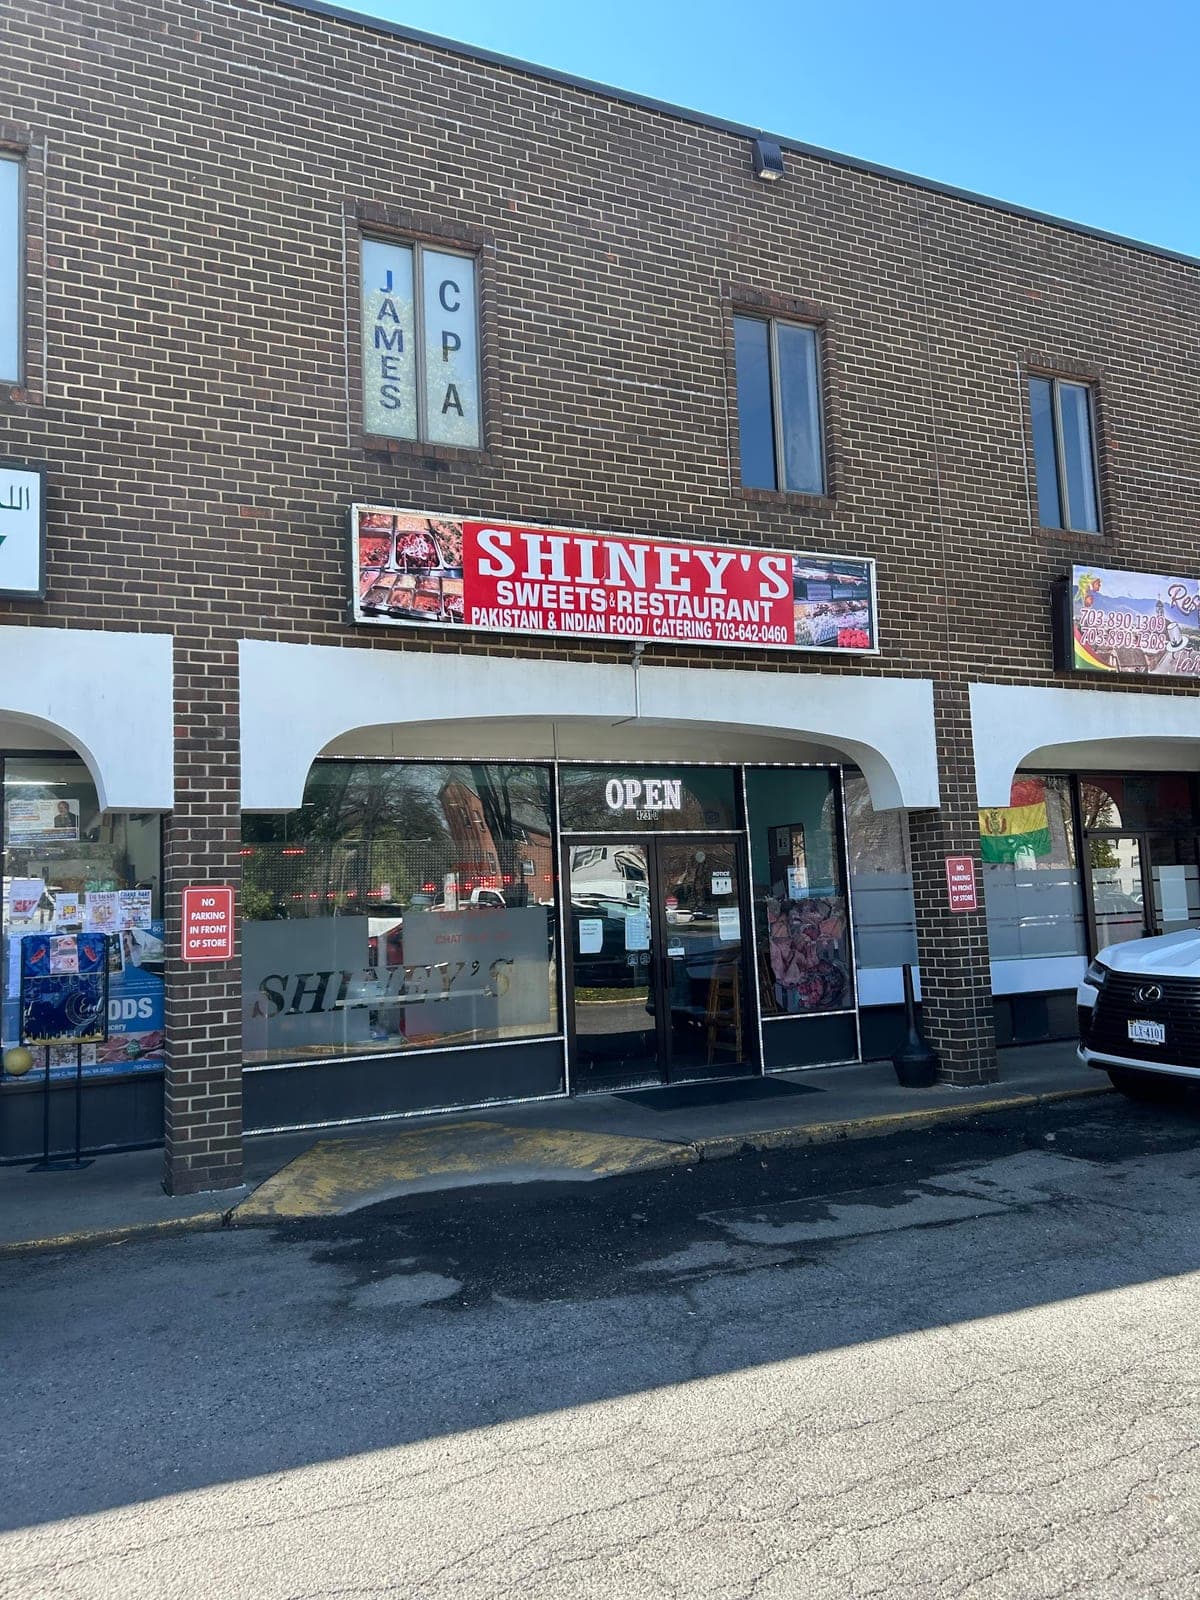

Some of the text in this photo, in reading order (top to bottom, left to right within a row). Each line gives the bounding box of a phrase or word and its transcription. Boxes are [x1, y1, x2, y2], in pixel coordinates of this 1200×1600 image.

[375, 270, 404, 410] JAMES
[438, 279, 464, 417] CPA
[476, 528, 790, 600] SHINEY'S
[496, 580, 774, 623] SWEETS & RESTAURANT
[471, 606, 543, 629] PAKISTANI
[547, 611, 557, 630] &
[561, 612, 605, 633] INDIAN
[609, 615, 643, 635] FOOD
[652, 617, 713, 638] CATERING
[715, 621, 788, 643] 703-642-0460
[605, 778, 682, 810] OPEN
[191, 911, 226, 921] PARKING
[201, 898, 215, 907] NO
[189, 924, 227, 934] IN FRONT
[189, 938, 227, 949] OF STORE
[108, 1024, 127, 1032] cery
